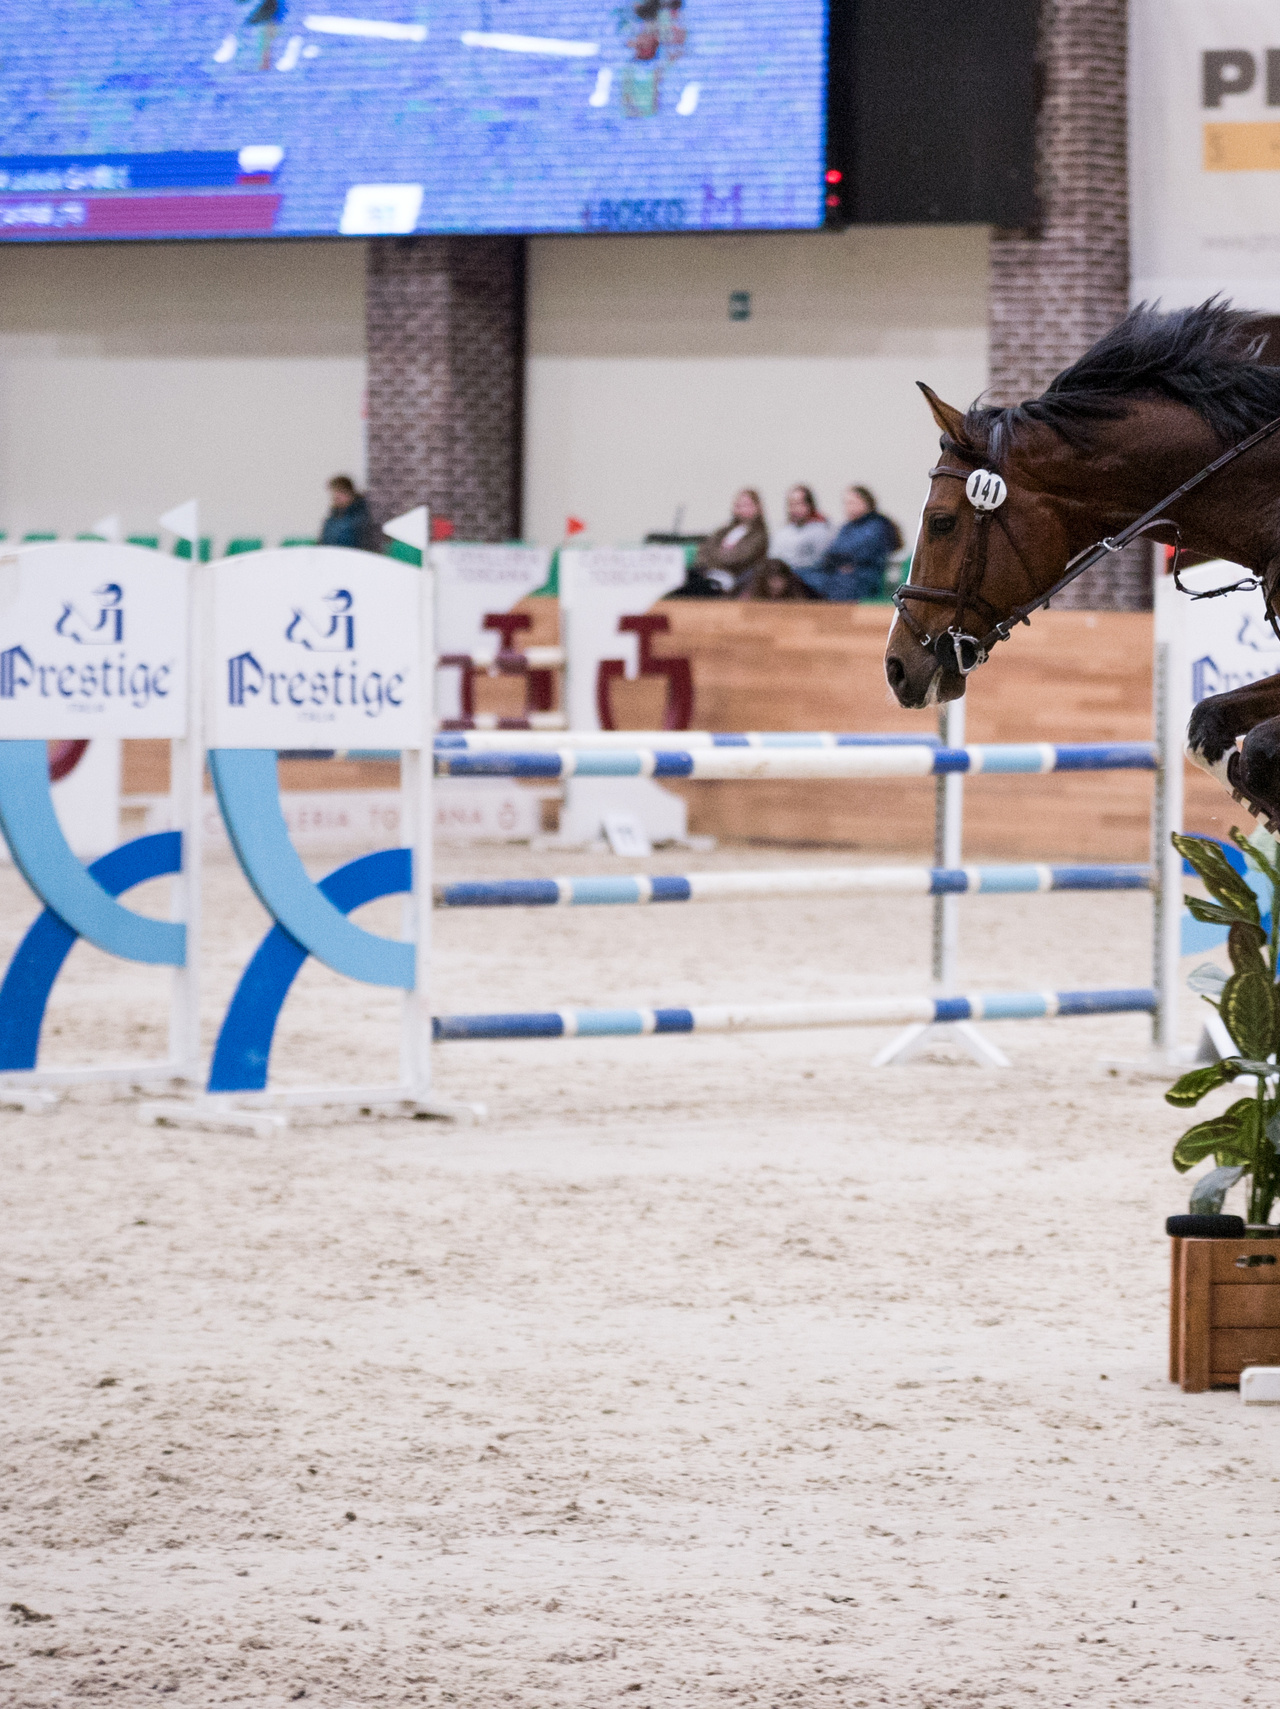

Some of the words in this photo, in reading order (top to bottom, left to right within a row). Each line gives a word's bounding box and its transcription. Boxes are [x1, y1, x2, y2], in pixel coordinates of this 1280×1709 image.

[971, 474, 1001, 504] 141
[0, 645, 172, 708] Prestige
[227, 652, 404, 718] Prestige
